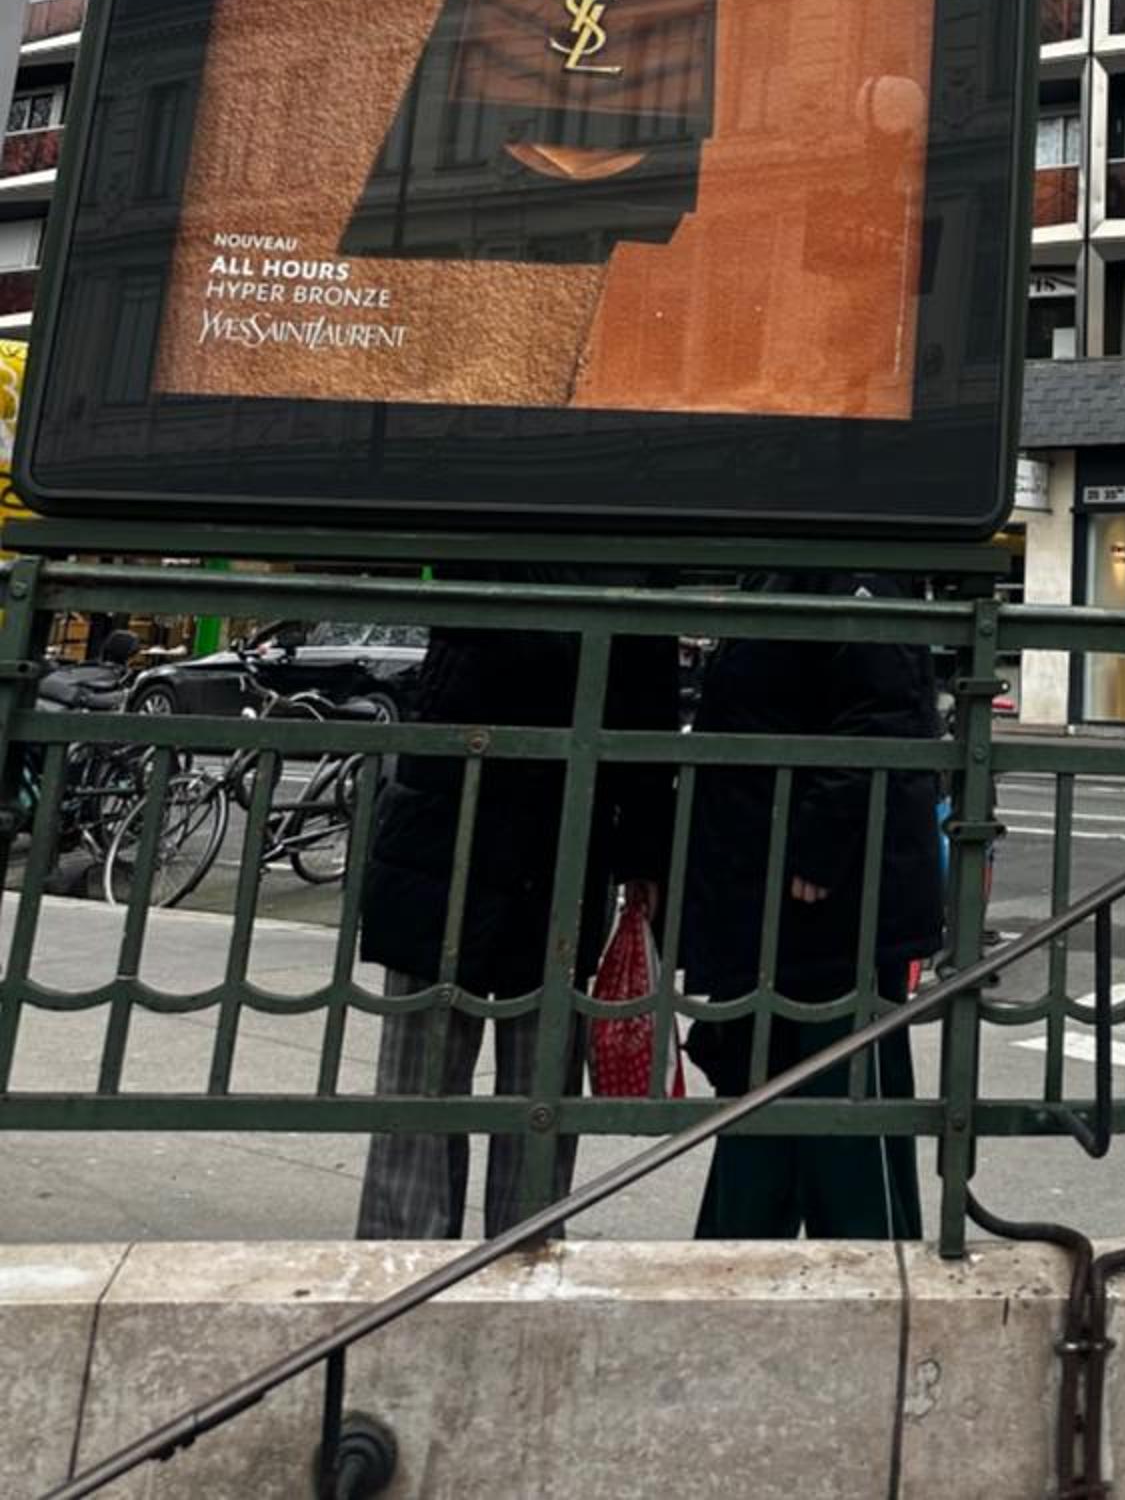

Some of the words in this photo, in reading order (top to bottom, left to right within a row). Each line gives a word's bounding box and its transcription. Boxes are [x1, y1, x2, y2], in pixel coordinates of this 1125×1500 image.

[213, 233, 298, 251] NOUVEAU
[208, 255, 254, 276] ALL
[262, 260, 350, 281] HOURS
[206, 280, 285, 302] HYPER
[293, 285, 391, 308] BRONZE
